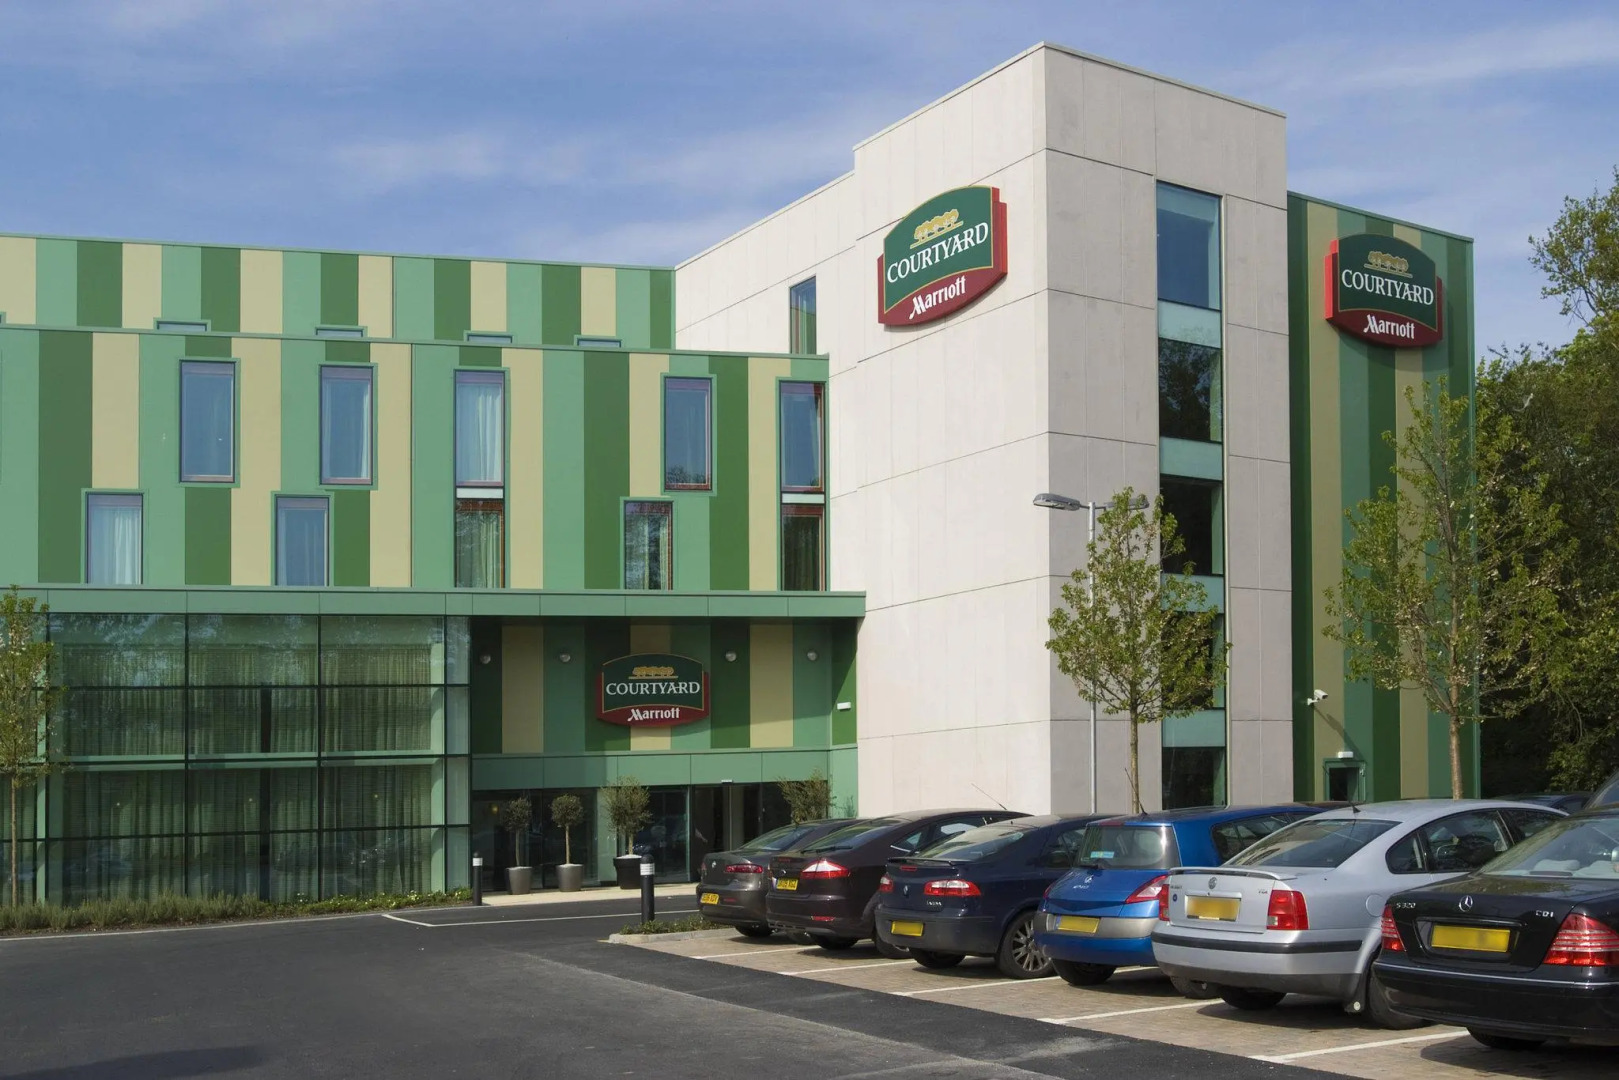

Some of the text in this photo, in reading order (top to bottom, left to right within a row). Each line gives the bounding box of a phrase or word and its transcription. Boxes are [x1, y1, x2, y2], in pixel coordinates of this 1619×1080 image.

[887, 222, 989, 283] COURTYARD
[909, 275, 966, 320] Marriott
[1341, 269, 1434, 306] COURTYARD
[1363, 314, 1415, 340] Marriott
[606, 681, 700, 696] COURTYARD
[627, 707, 681, 722] Marriott
